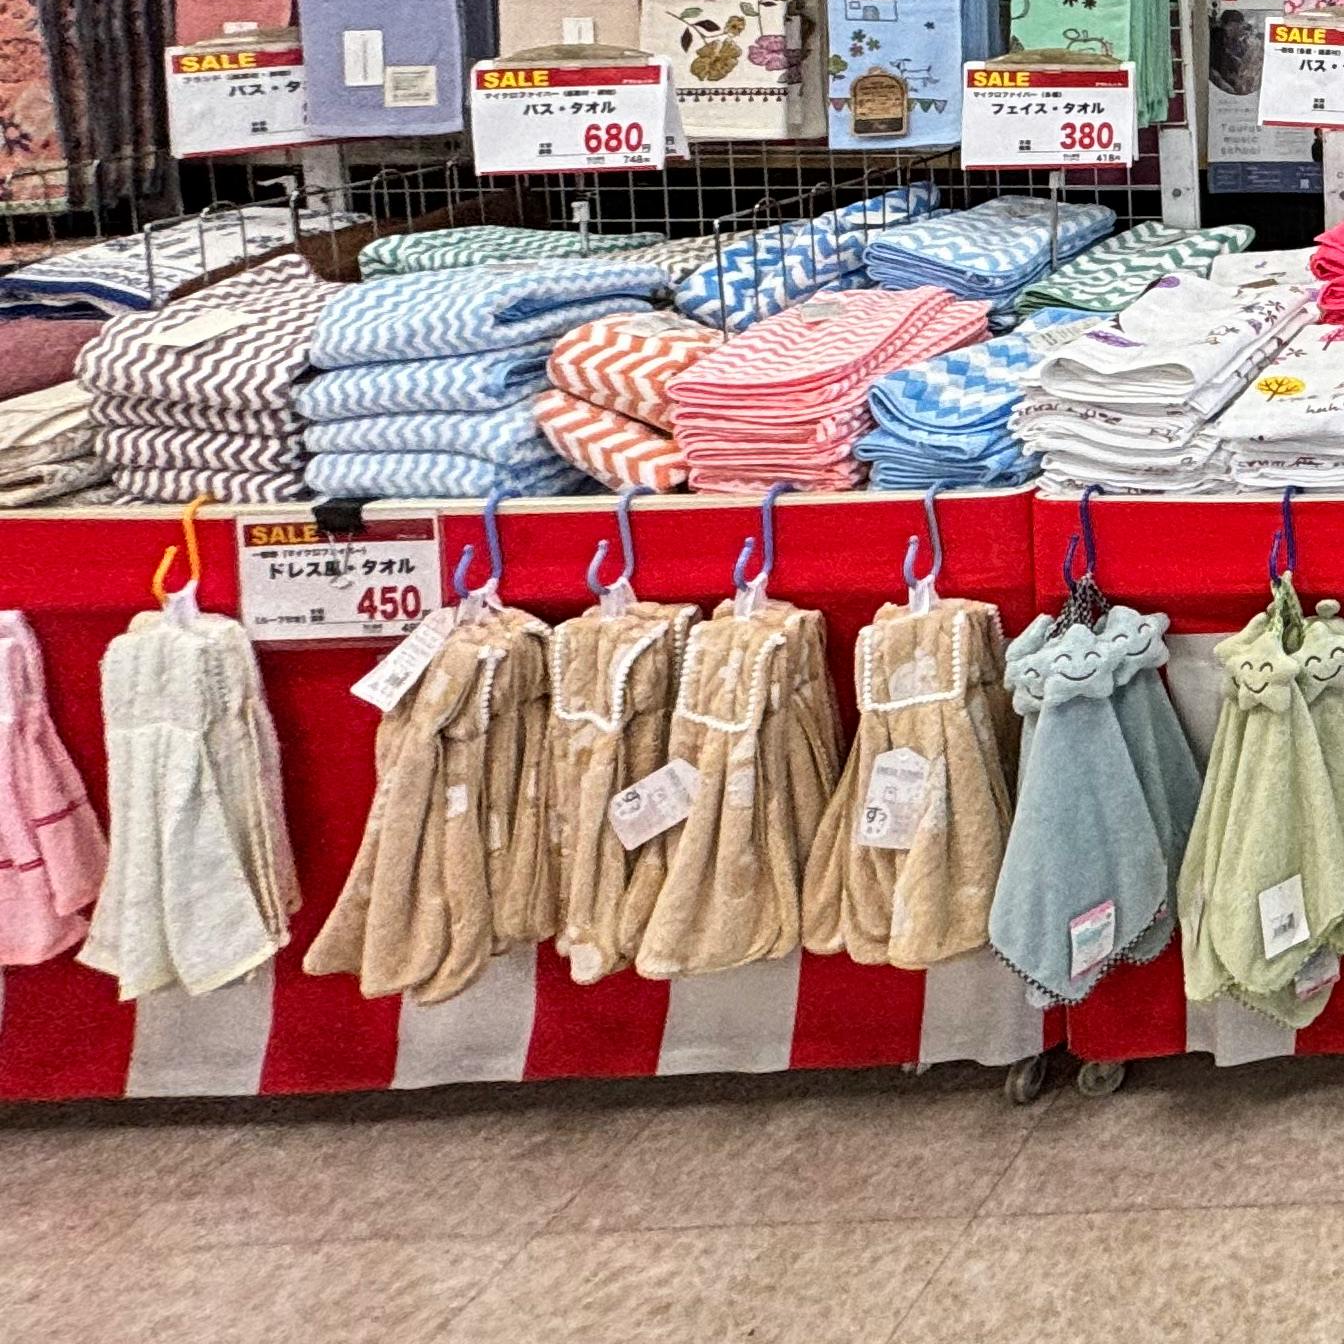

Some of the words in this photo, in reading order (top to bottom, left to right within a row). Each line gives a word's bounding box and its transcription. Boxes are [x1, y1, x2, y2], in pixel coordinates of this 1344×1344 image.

[1275, 27, 1327, 44] SALE
[180, 53, 257, 72] SALE
[484, 70, 550, 88] SALE
[973, 71, 1031, 87] SALE
[523, 102, 616, 115] バス・タオル
[991, 103, 1105, 115] フェイス・タオル
[251, 524, 320, 545] SALE
[269, 558, 416, 579] ドレス風・タオル
